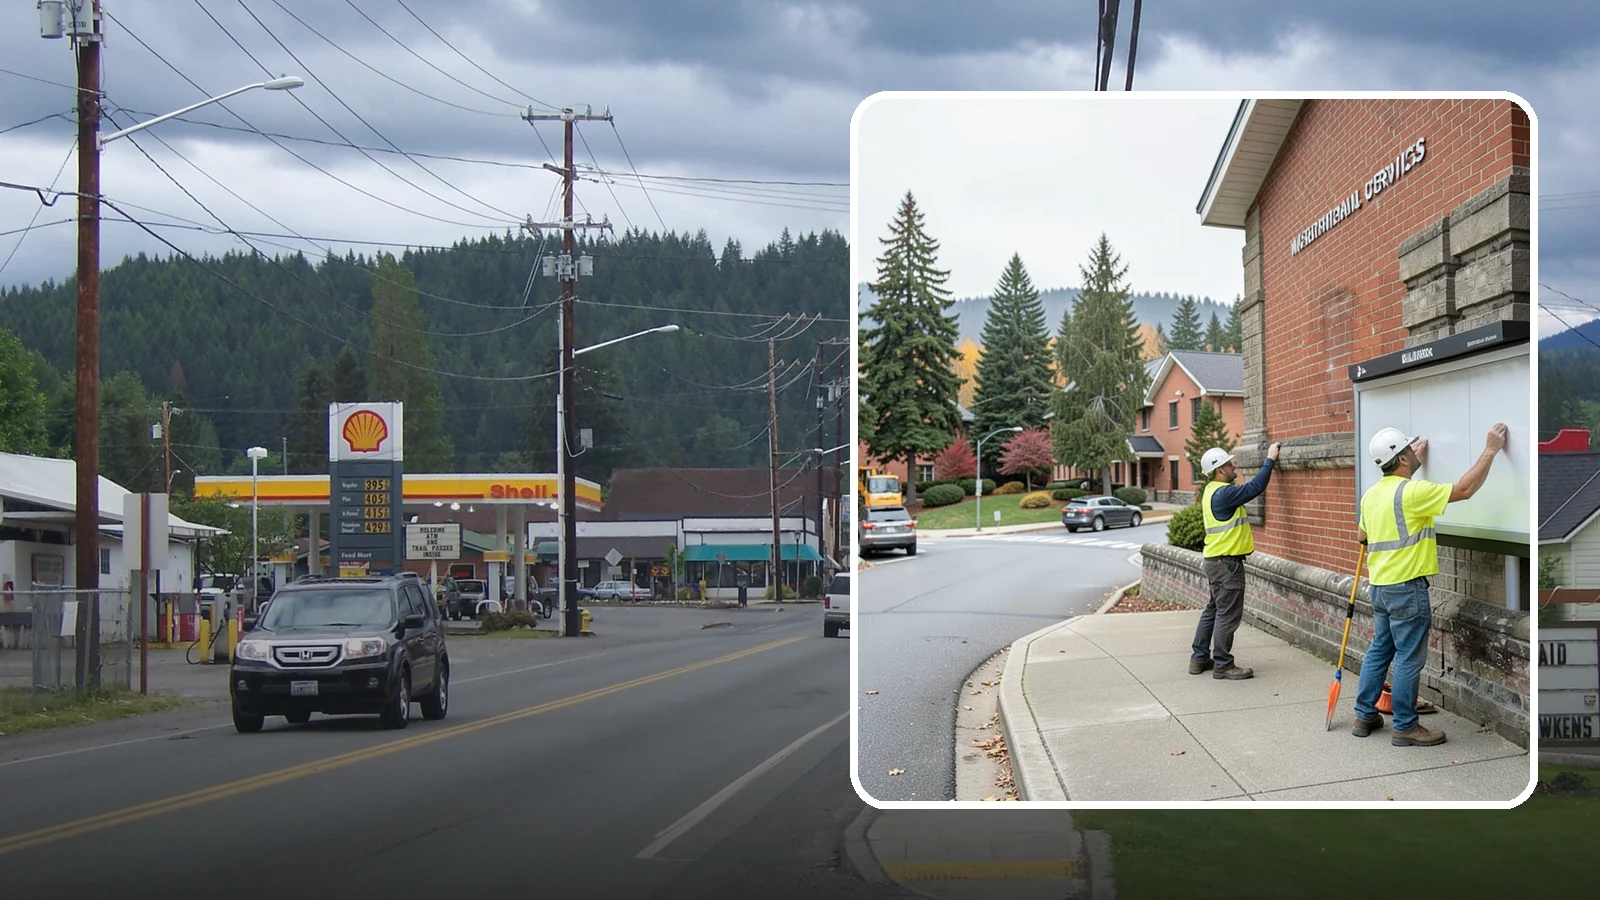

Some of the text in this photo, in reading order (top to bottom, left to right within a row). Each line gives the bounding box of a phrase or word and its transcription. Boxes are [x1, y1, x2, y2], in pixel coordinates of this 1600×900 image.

[365, 480, 384, 490] 395
[490, 484, 547, 499] Shell
[365, 494, 384, 504] 405
[365, 508, 384, 518] 415
[365, 522, 384, 532] 429
